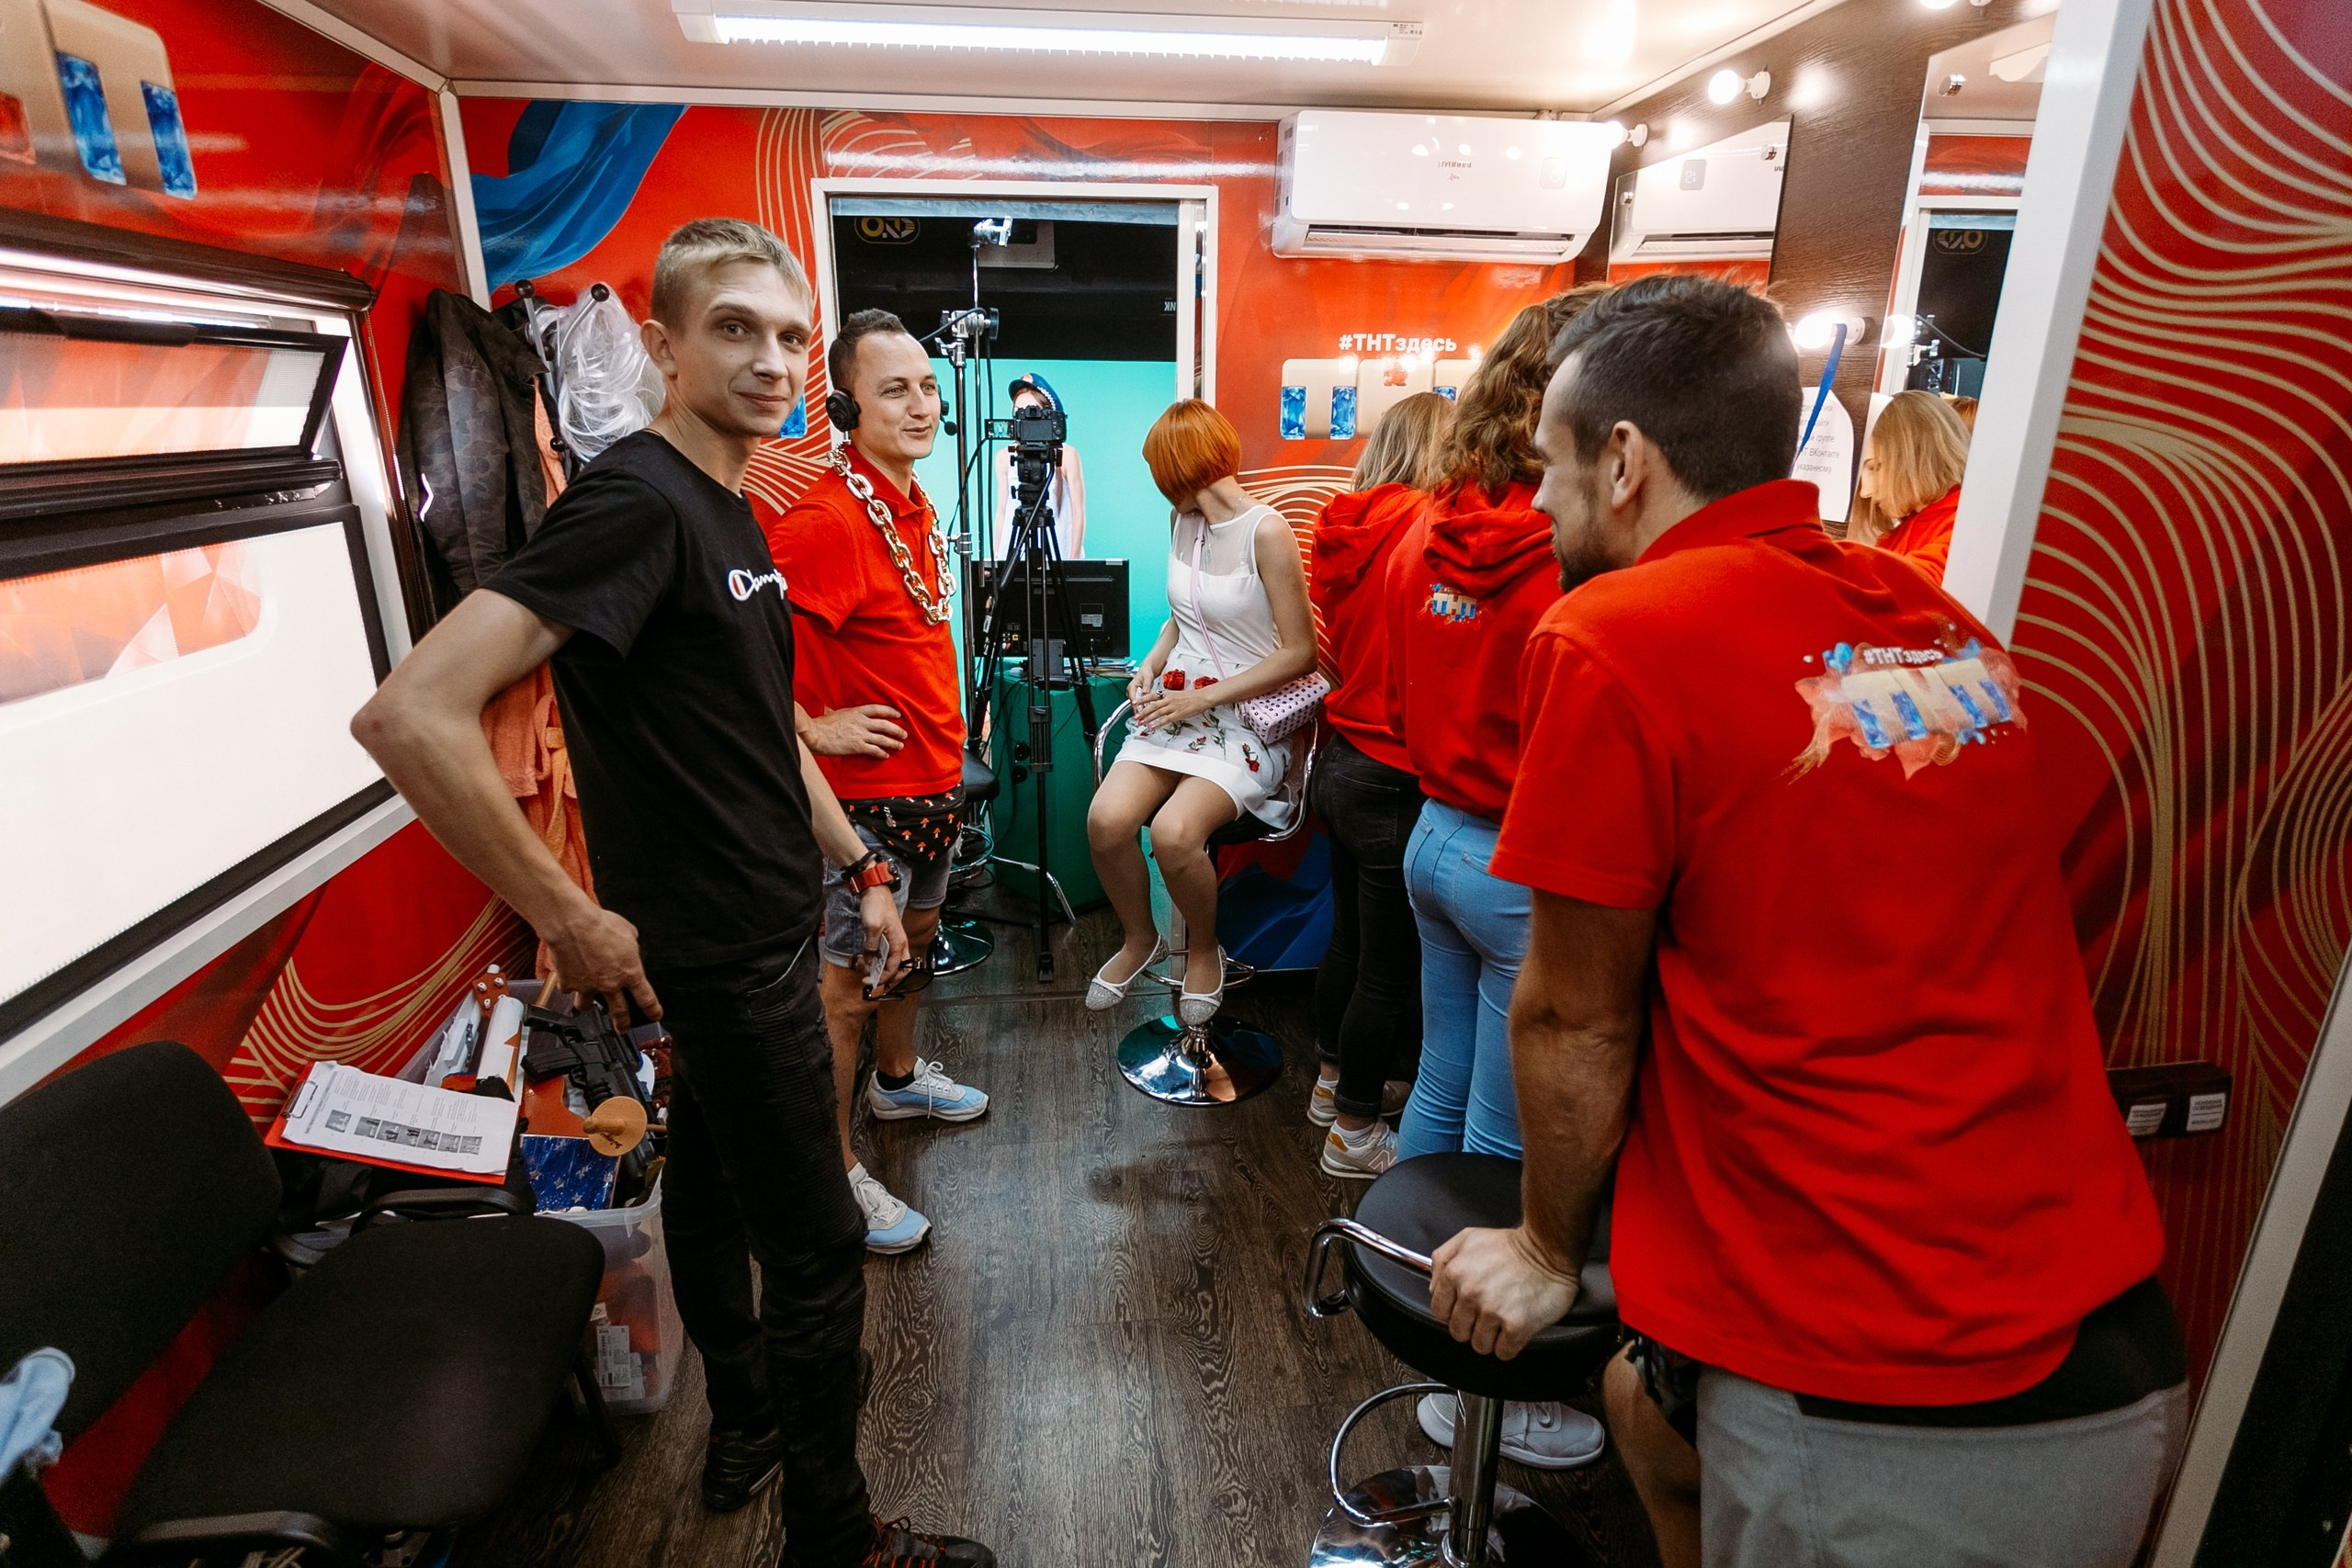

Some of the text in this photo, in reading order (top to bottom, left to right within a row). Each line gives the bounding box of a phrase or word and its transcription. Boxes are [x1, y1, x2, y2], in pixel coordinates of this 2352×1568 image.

[1339, 333, 1457, 354] #ТНТздесь
[1432, 592, 1477, 619] ТНТ
[1863, 647, 1943, 665] #ТНТздесь
[1840, 658, 2011, 749] ТНТ
